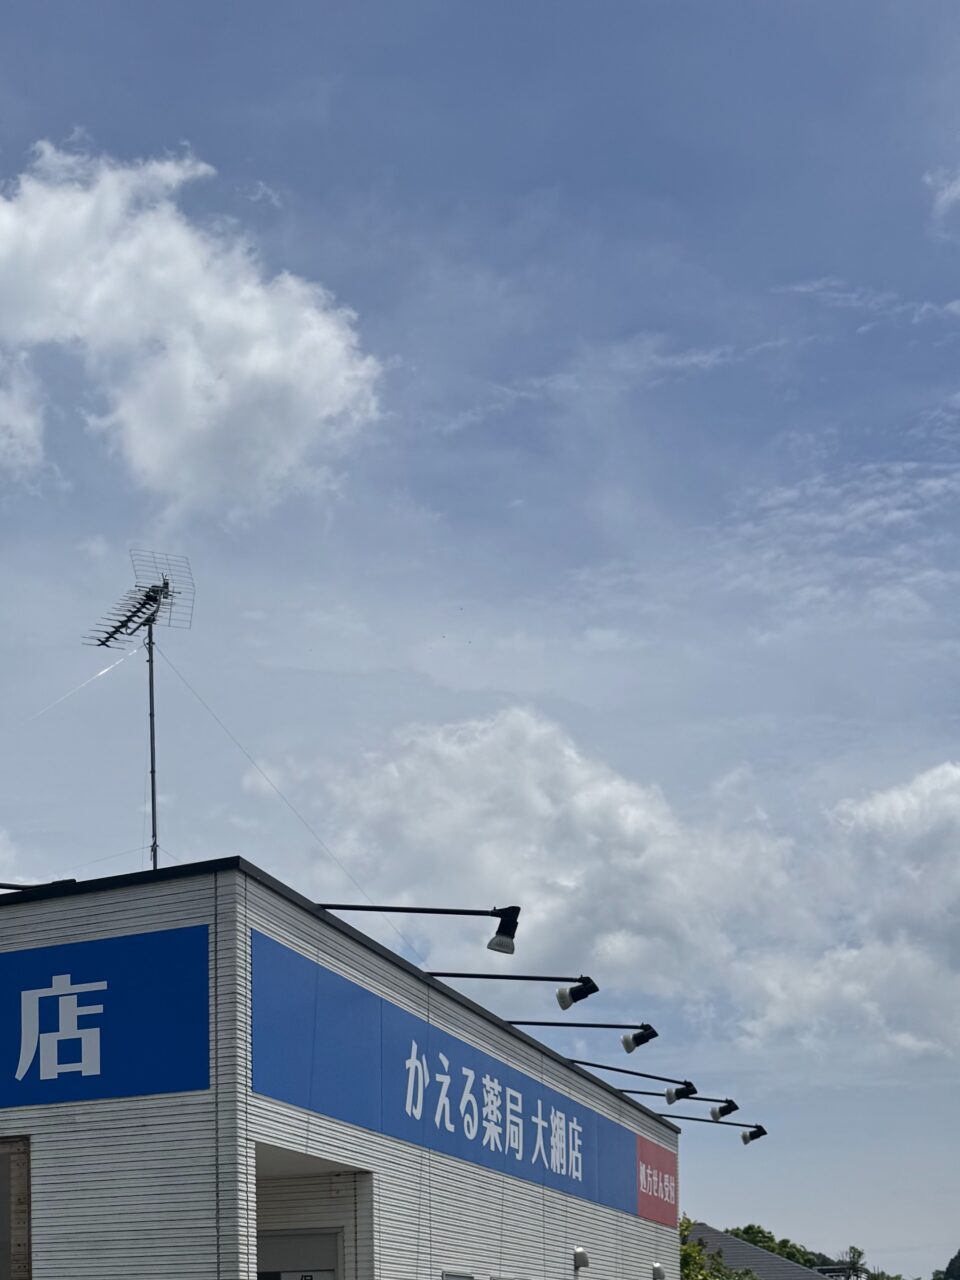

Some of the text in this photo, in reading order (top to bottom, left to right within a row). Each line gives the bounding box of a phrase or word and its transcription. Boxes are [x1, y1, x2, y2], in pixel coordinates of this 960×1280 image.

[404, 1039, 583, 1182] かえる薬局 大網店
[639, 1160, 676, 1205] 処方せん受付
